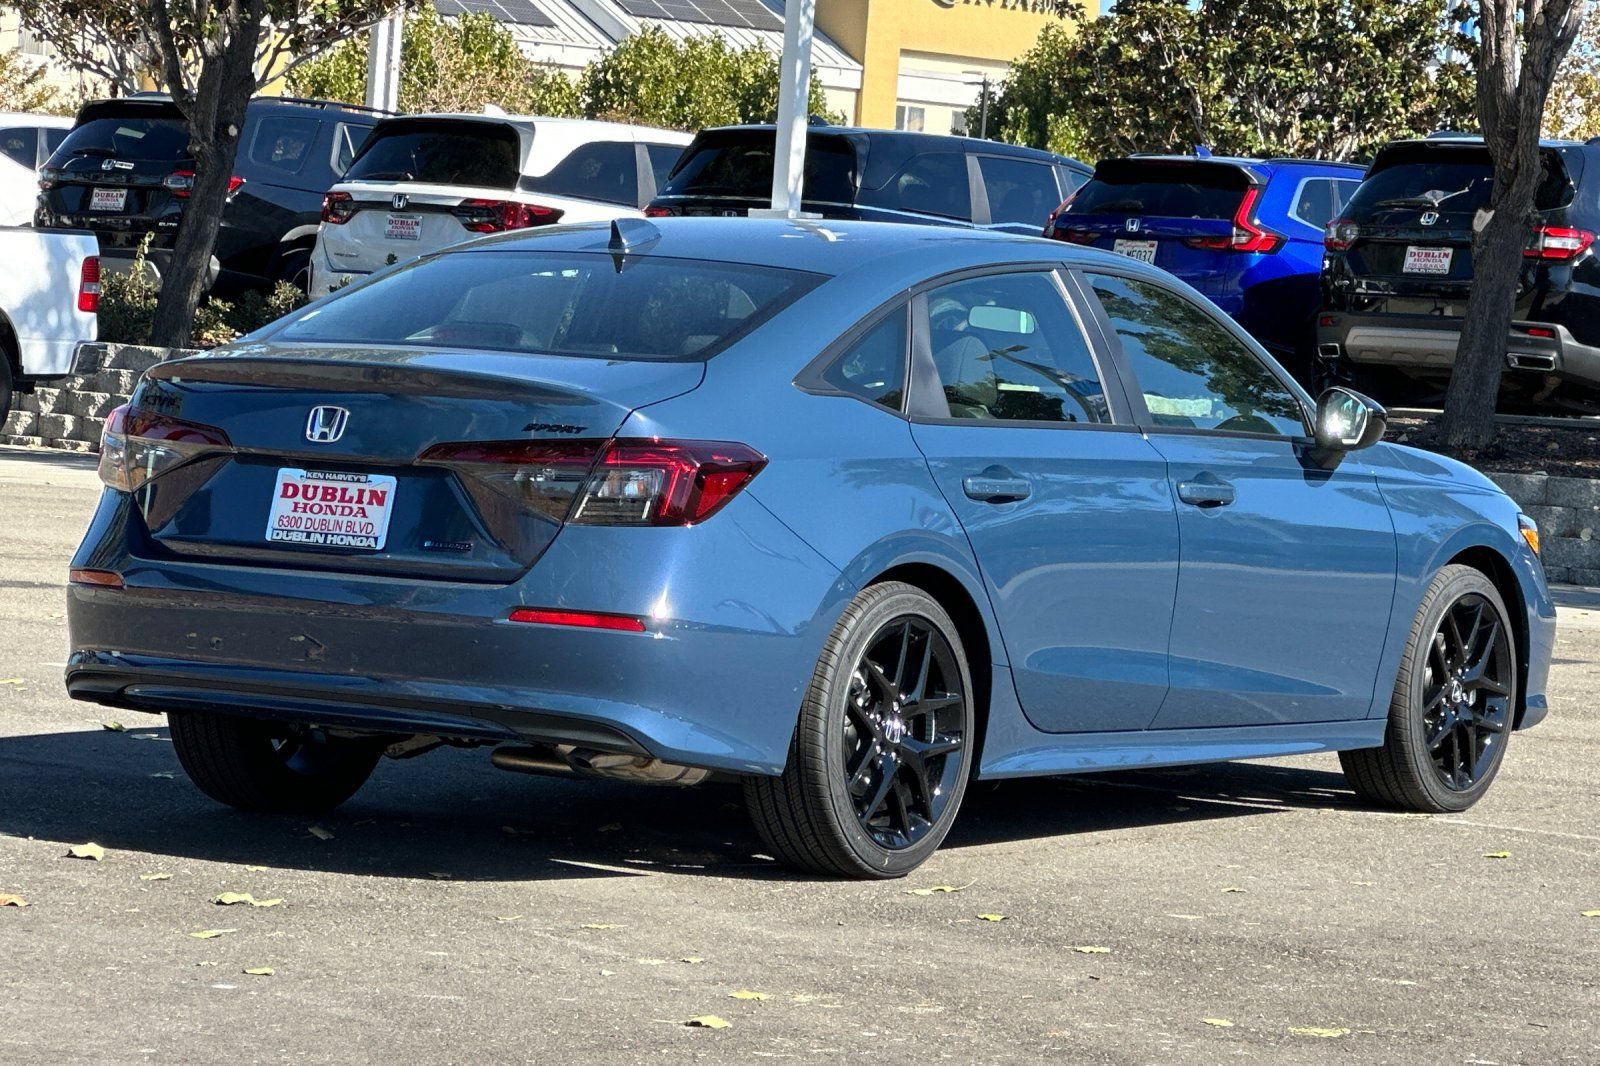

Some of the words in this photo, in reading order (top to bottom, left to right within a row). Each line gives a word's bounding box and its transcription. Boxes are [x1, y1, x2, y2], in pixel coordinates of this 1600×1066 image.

[388, 219, 419, 227] DUBLIN
[1409, 251, 1449, 259] DUBLIN
[306, 471, 325, 480] KEN
[325, 473, 367, 483] HARVEY'S
[280, 483, 387, 507] DUBLIN
[291, 502, 368, 518] HONDA
[278, 515, 302, 529] 6300
[304, 517, 343, 532] DUBLIN
[345, 520, 376, 535] BLVD.
[272, 530, 325, 544] DUBLIN
[326, 534, 376, 548] HONDA
